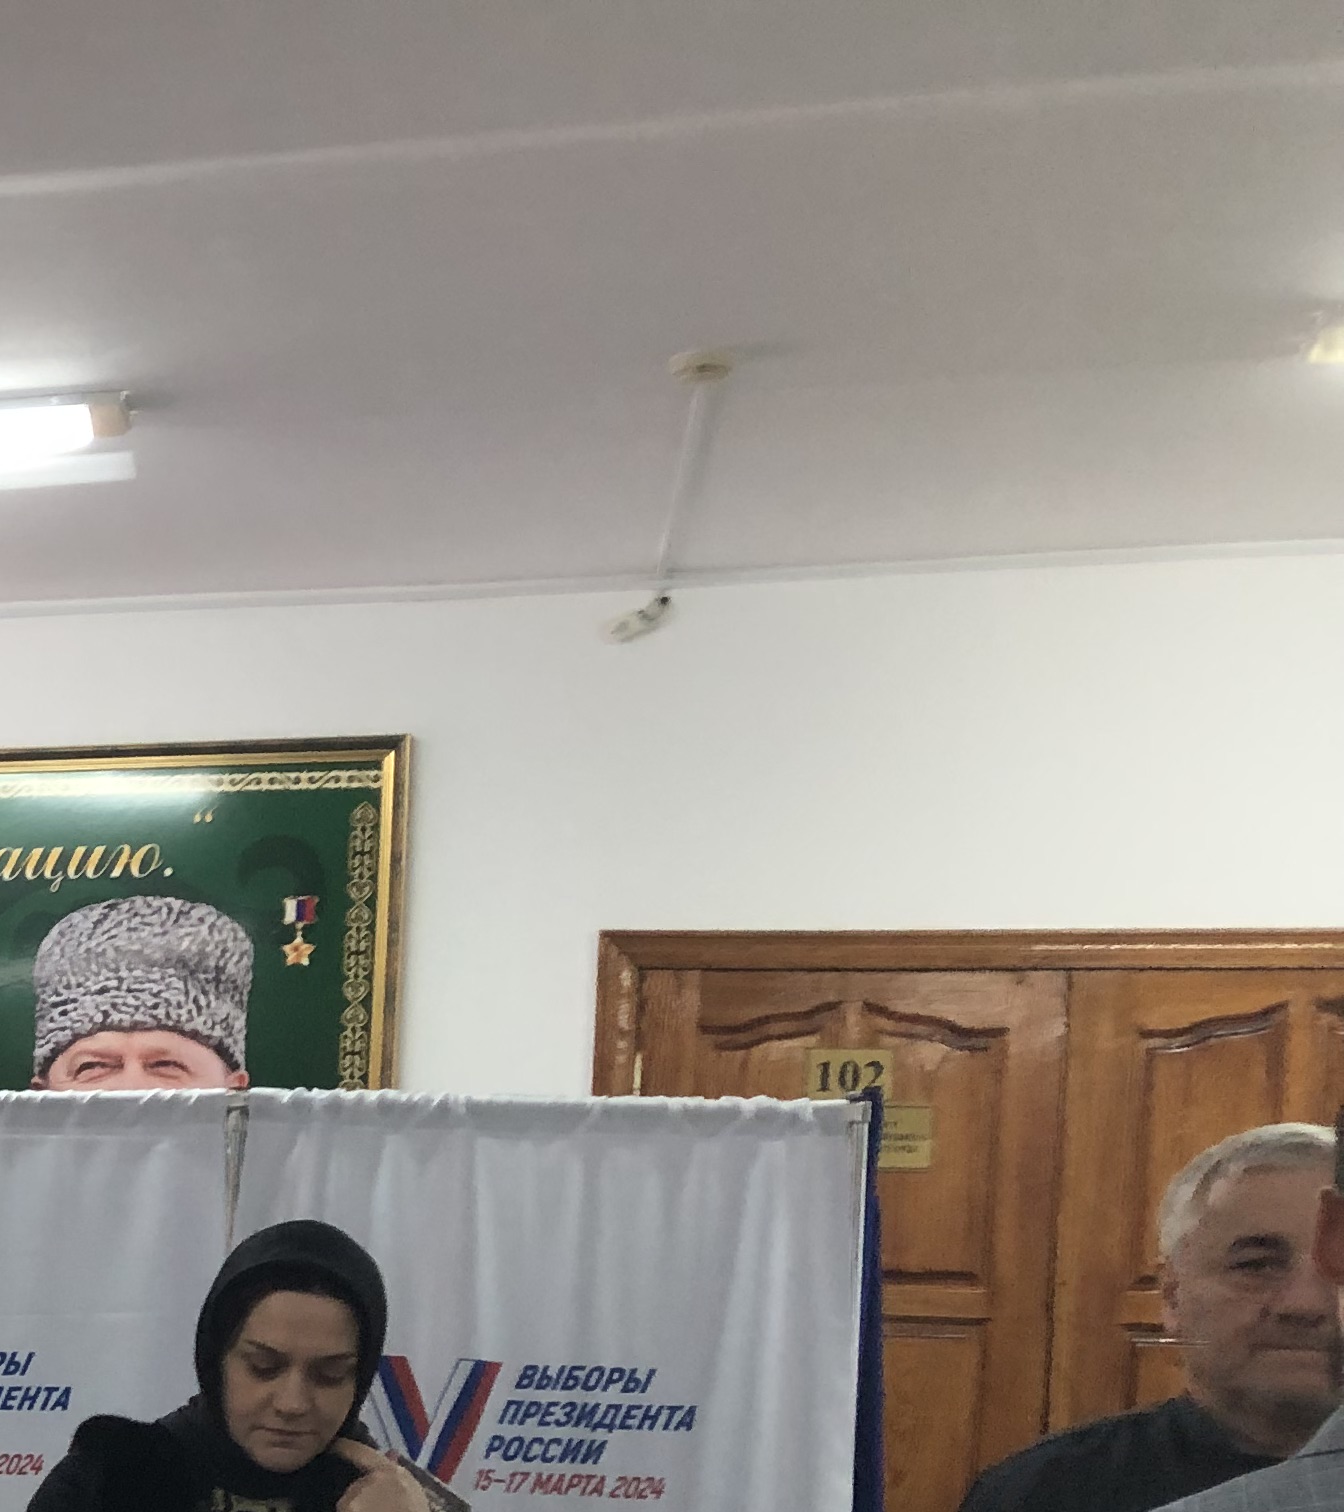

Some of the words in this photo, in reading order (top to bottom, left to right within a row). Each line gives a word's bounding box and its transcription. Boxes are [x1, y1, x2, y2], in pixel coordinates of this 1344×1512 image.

[816, 1059, 885, 1092] 102
[514, 1363, 658, 1394] ВЫБОРЫ
[497, 1399, 698, 1433] ПРЕЗИДЕНТА
[483, 1434, 608, 1465] РОССИИ
[529, 1470, 608, 1497] МАРТА
[609, 1475, 667, 1500] 2024
